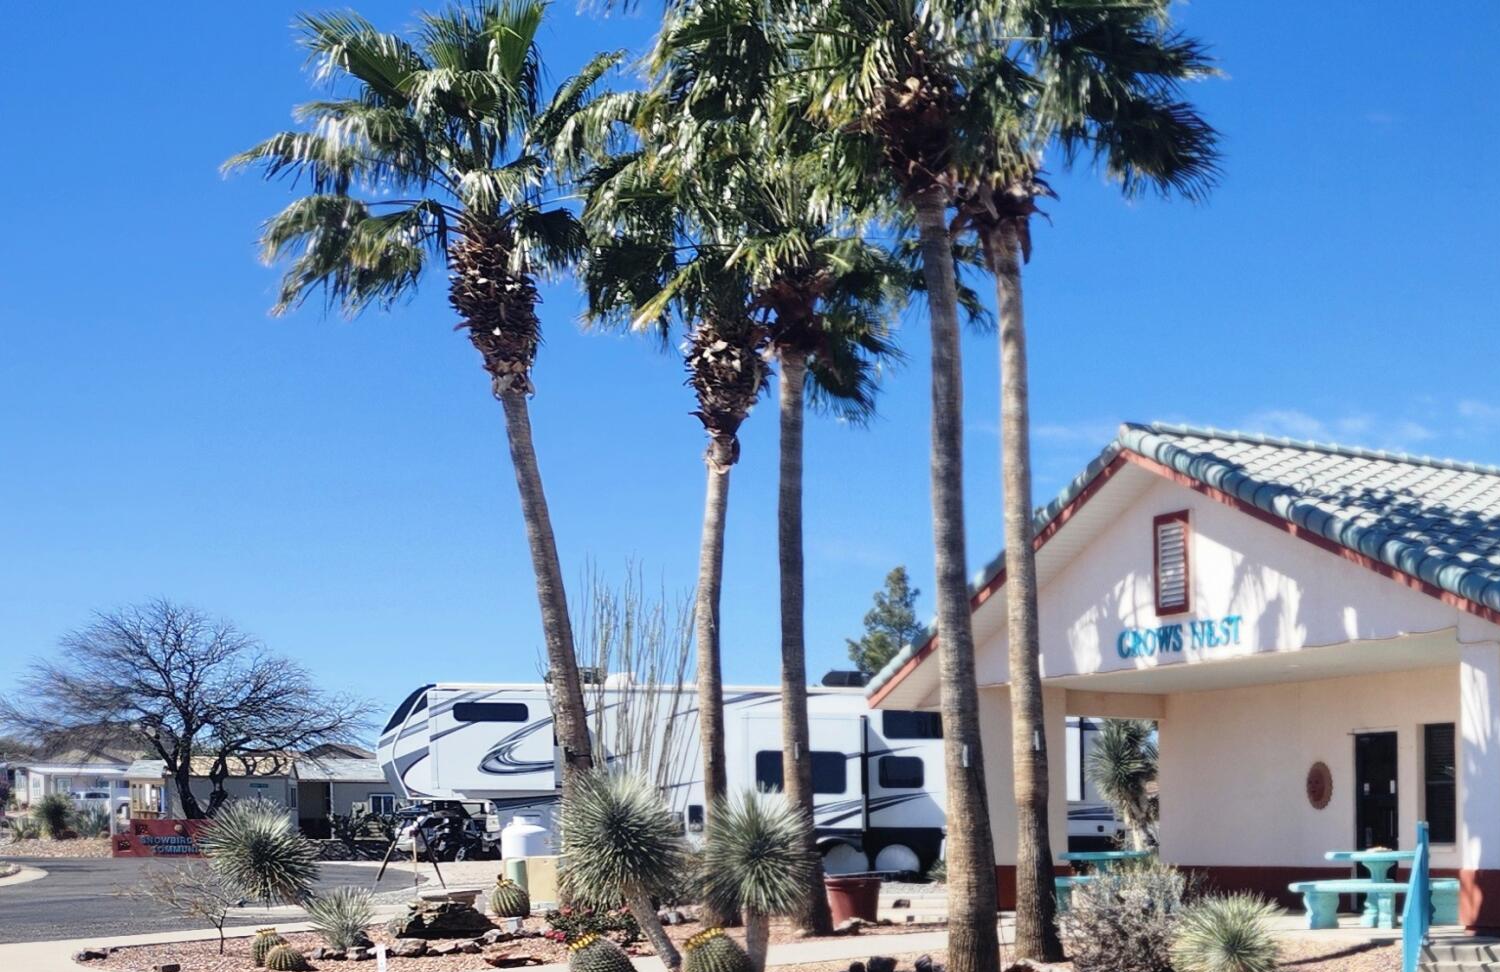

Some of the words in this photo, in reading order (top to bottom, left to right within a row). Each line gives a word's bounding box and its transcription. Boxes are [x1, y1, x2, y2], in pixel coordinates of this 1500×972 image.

[1117, 623, 1183, 659] CROWS
[1189, 614, 1242, 650] NEST
[151, 844, 199, 854] COMMUNI
